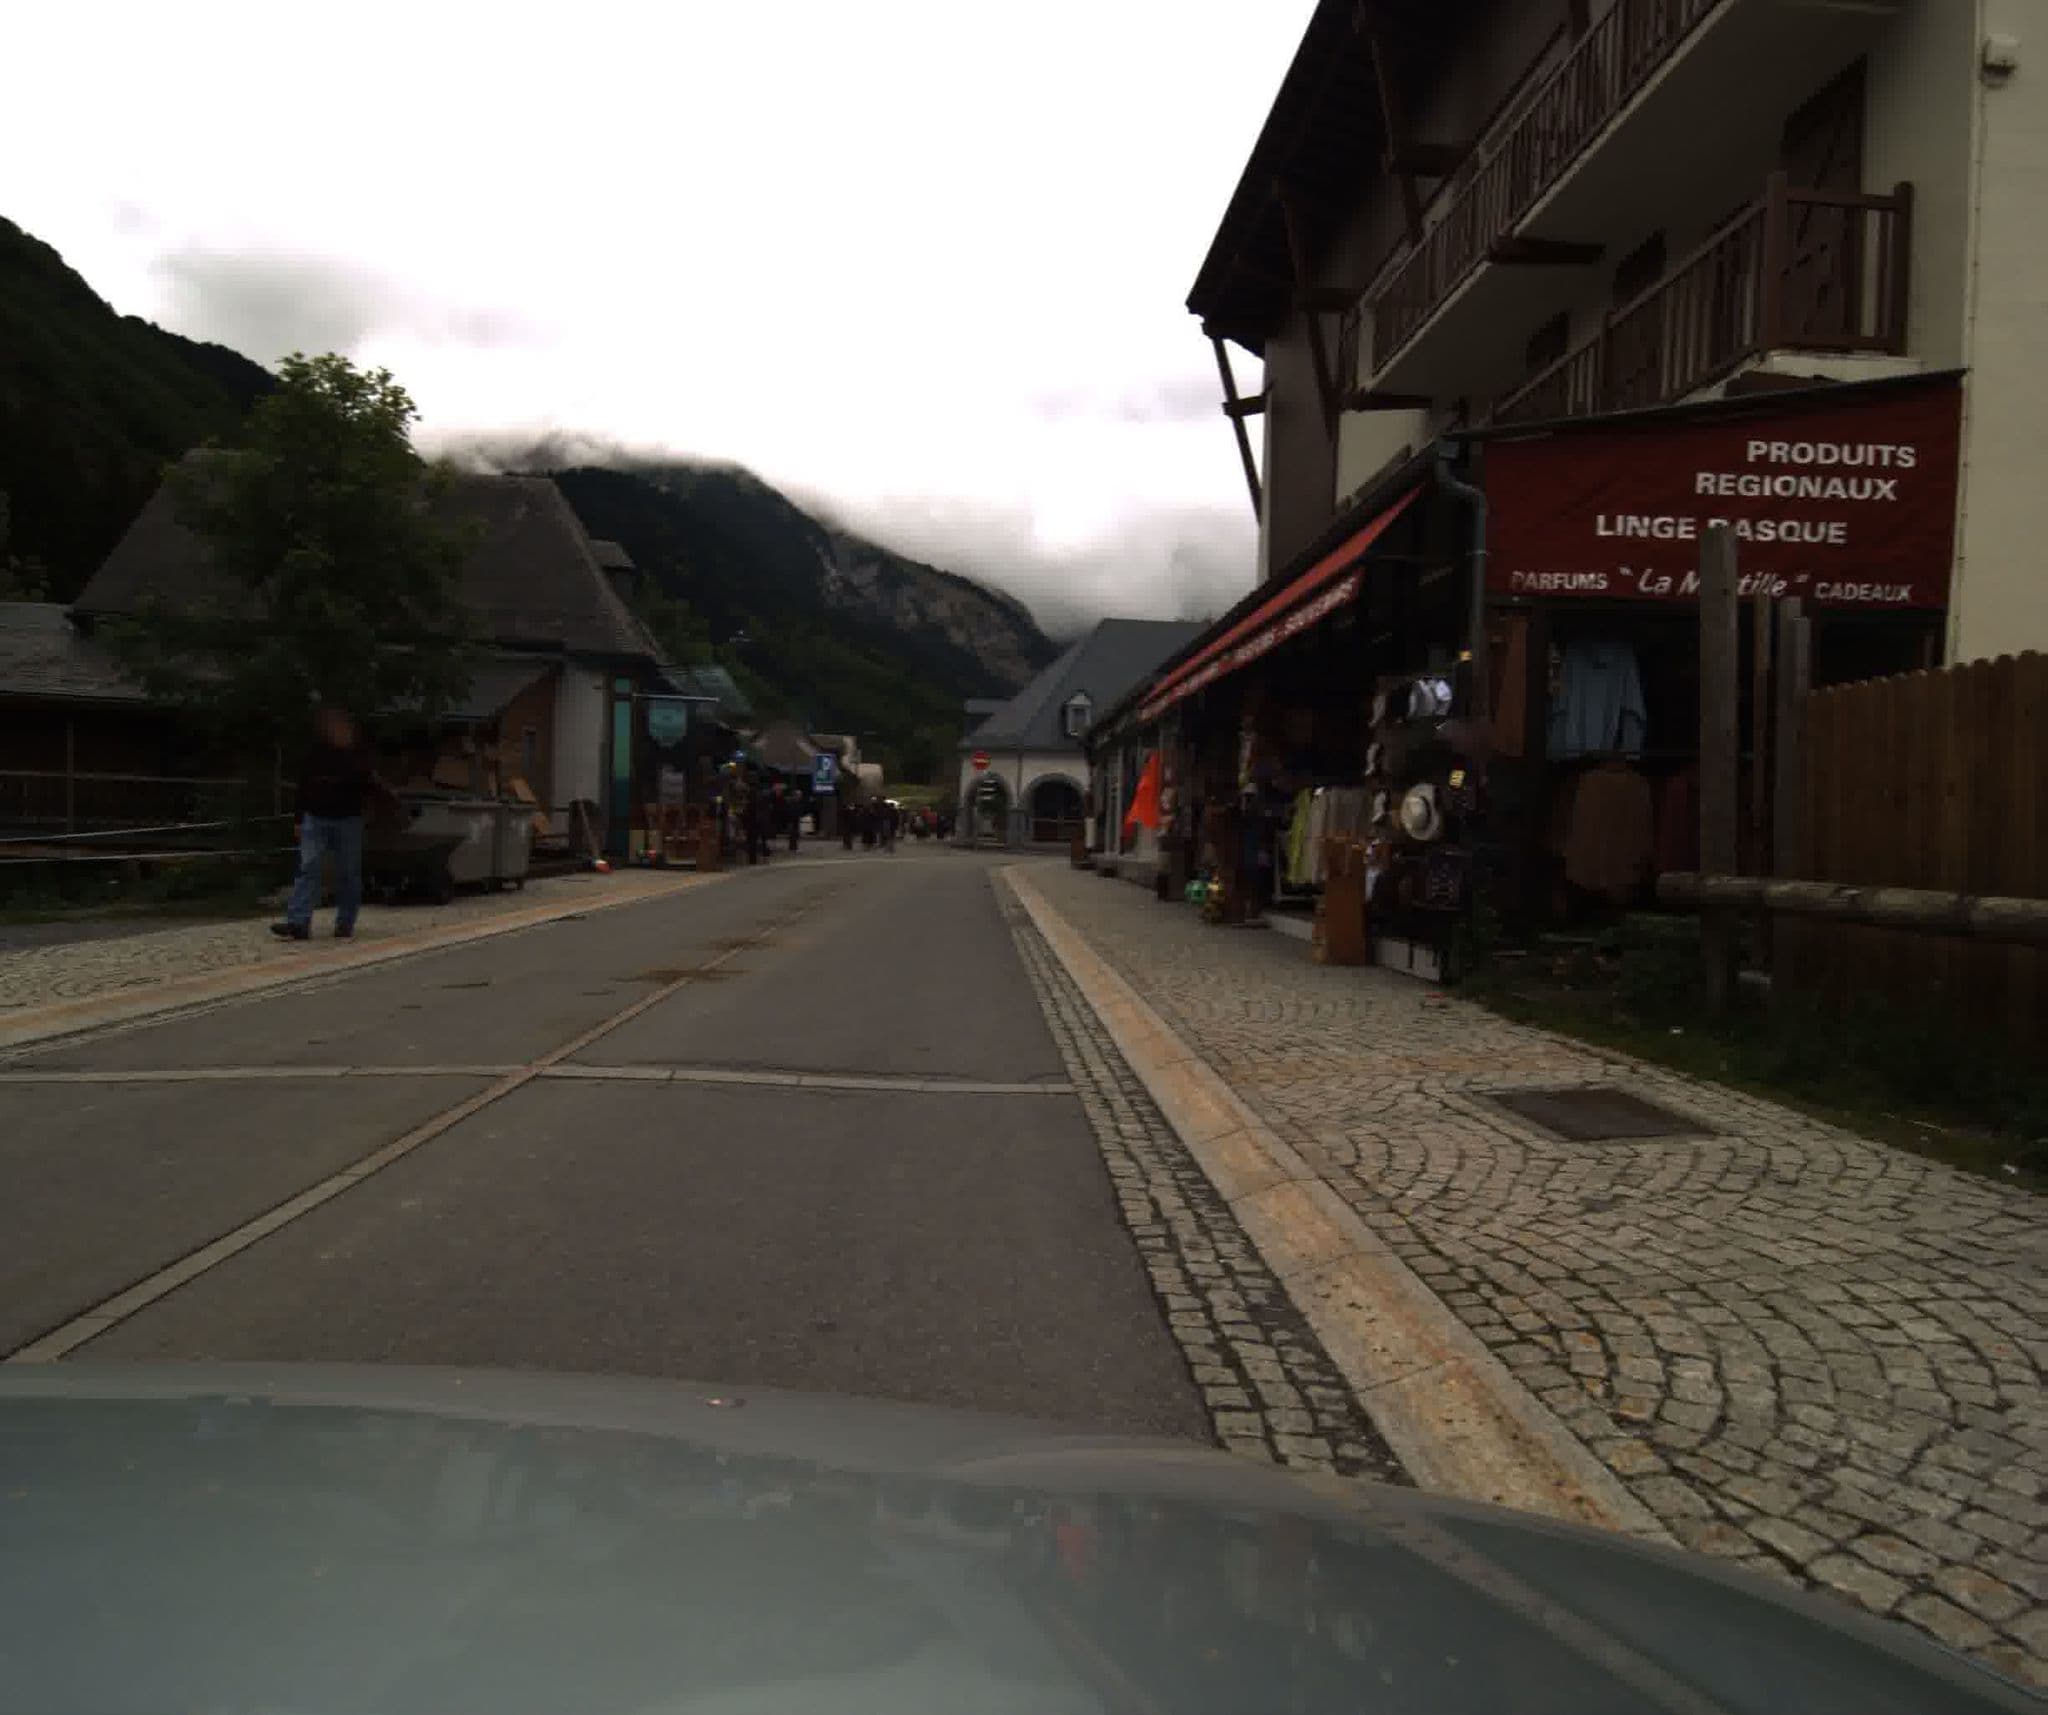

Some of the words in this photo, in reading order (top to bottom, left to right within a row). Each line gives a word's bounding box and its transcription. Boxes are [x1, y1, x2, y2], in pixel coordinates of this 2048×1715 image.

[1746, 439, 1917, 468] PRODUITS
[1694, 471, 1898, 501] REGIONAUX
[1595, 514, 1697, 539] LINGE
[1511, 570, 1609, 591] PARFUMS
[1814, 581, 1914, 602] CADEAUX
